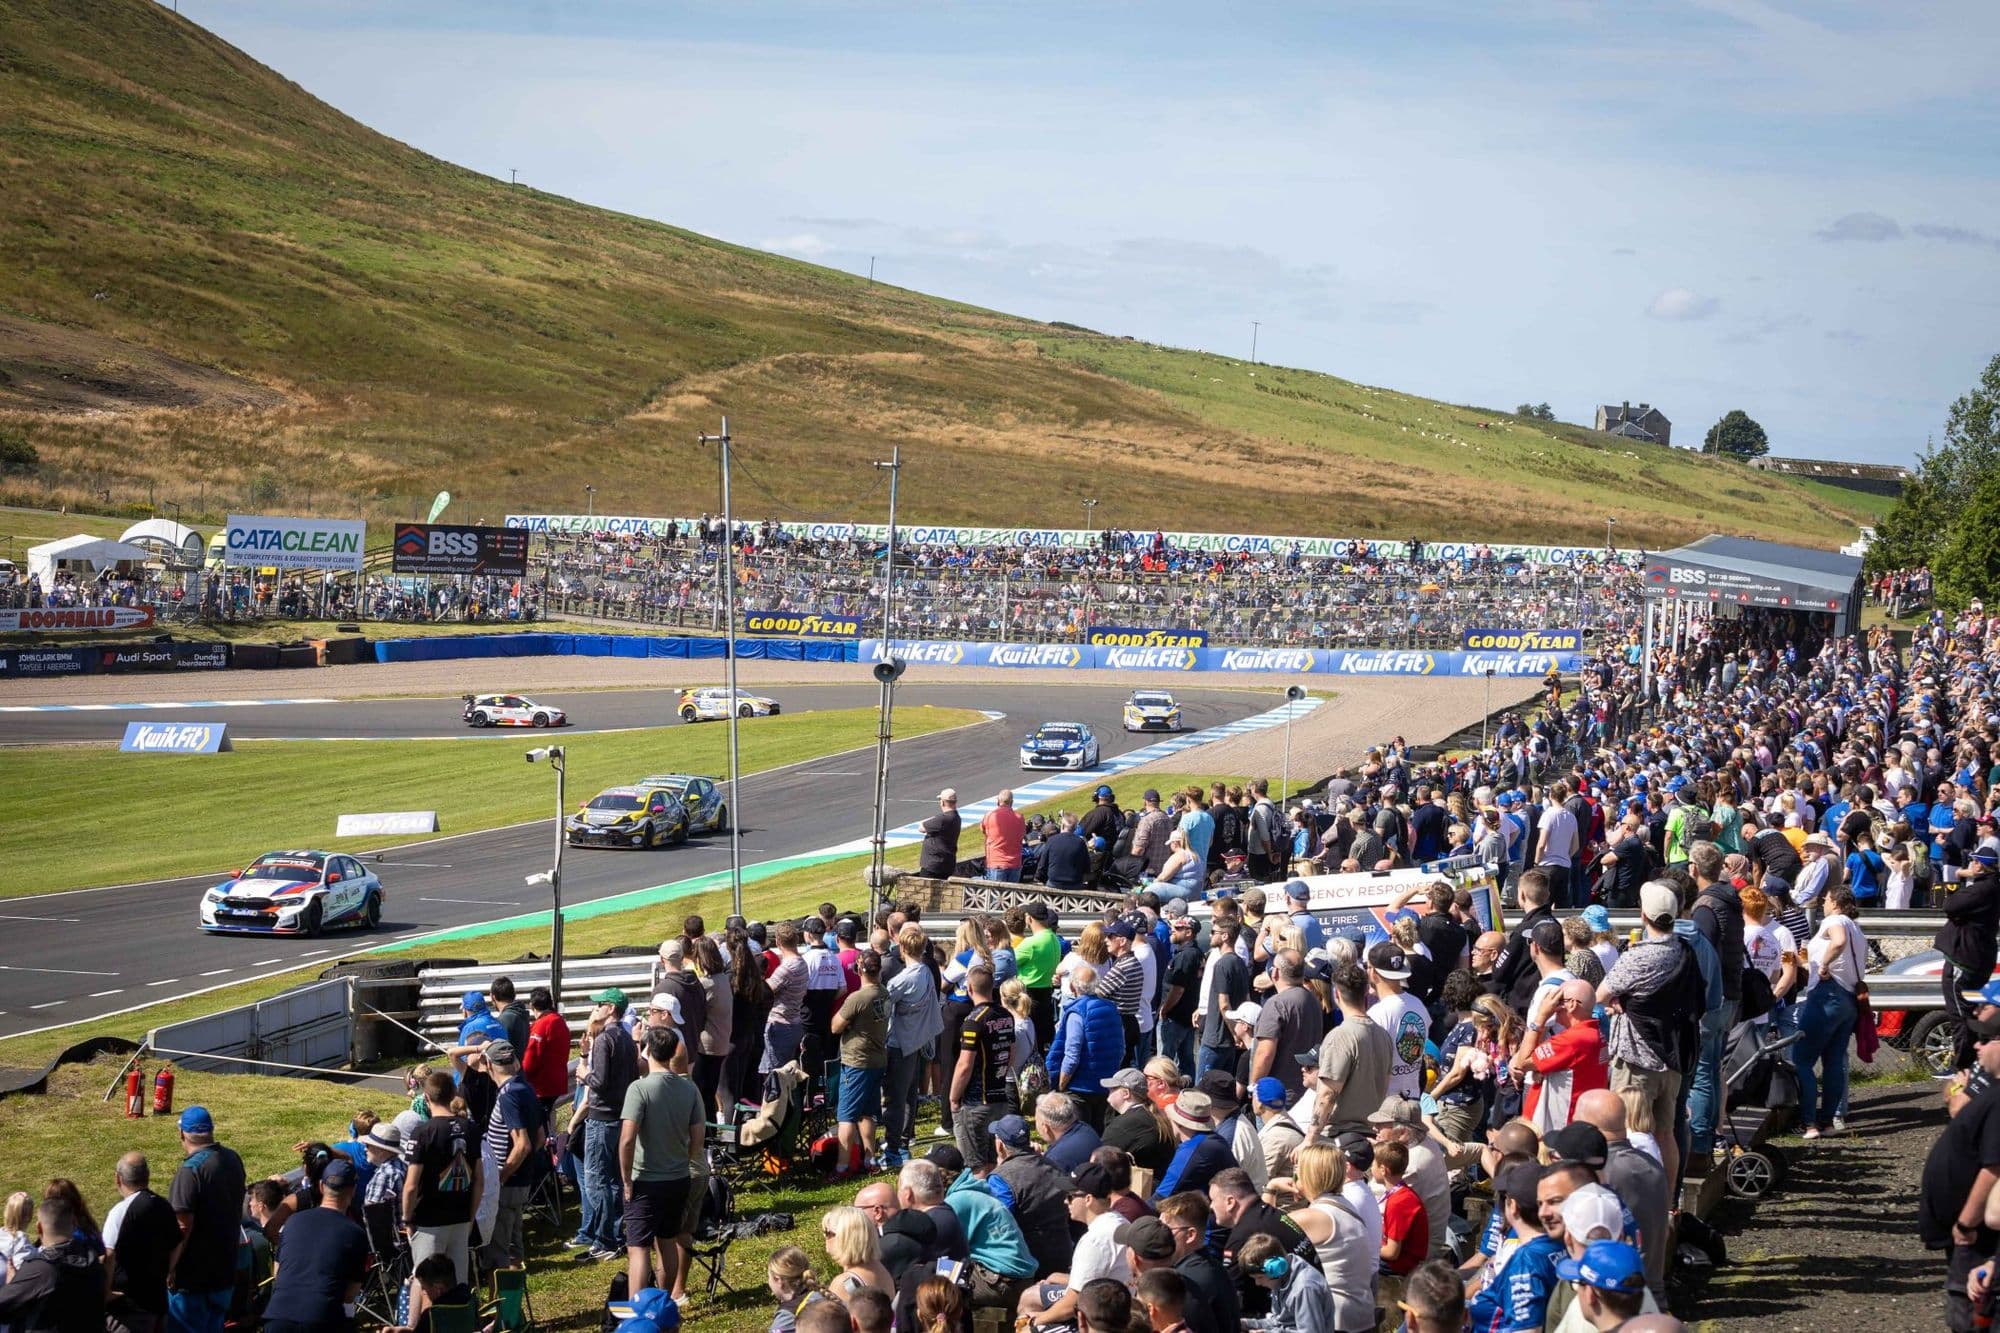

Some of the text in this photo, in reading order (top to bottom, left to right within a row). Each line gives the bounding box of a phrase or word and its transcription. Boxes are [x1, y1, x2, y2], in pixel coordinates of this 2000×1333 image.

[228, 528, 359, 553] CATACLEAN
[428, 531, 478, 556] BSS
[1670, 567, 1706, 585] BSS
[116, 651, 172, 663] Audi Sport
[1267, 887, 1355, 903] EMGENCY
[1332, 915, 1358, 925] FIRES
